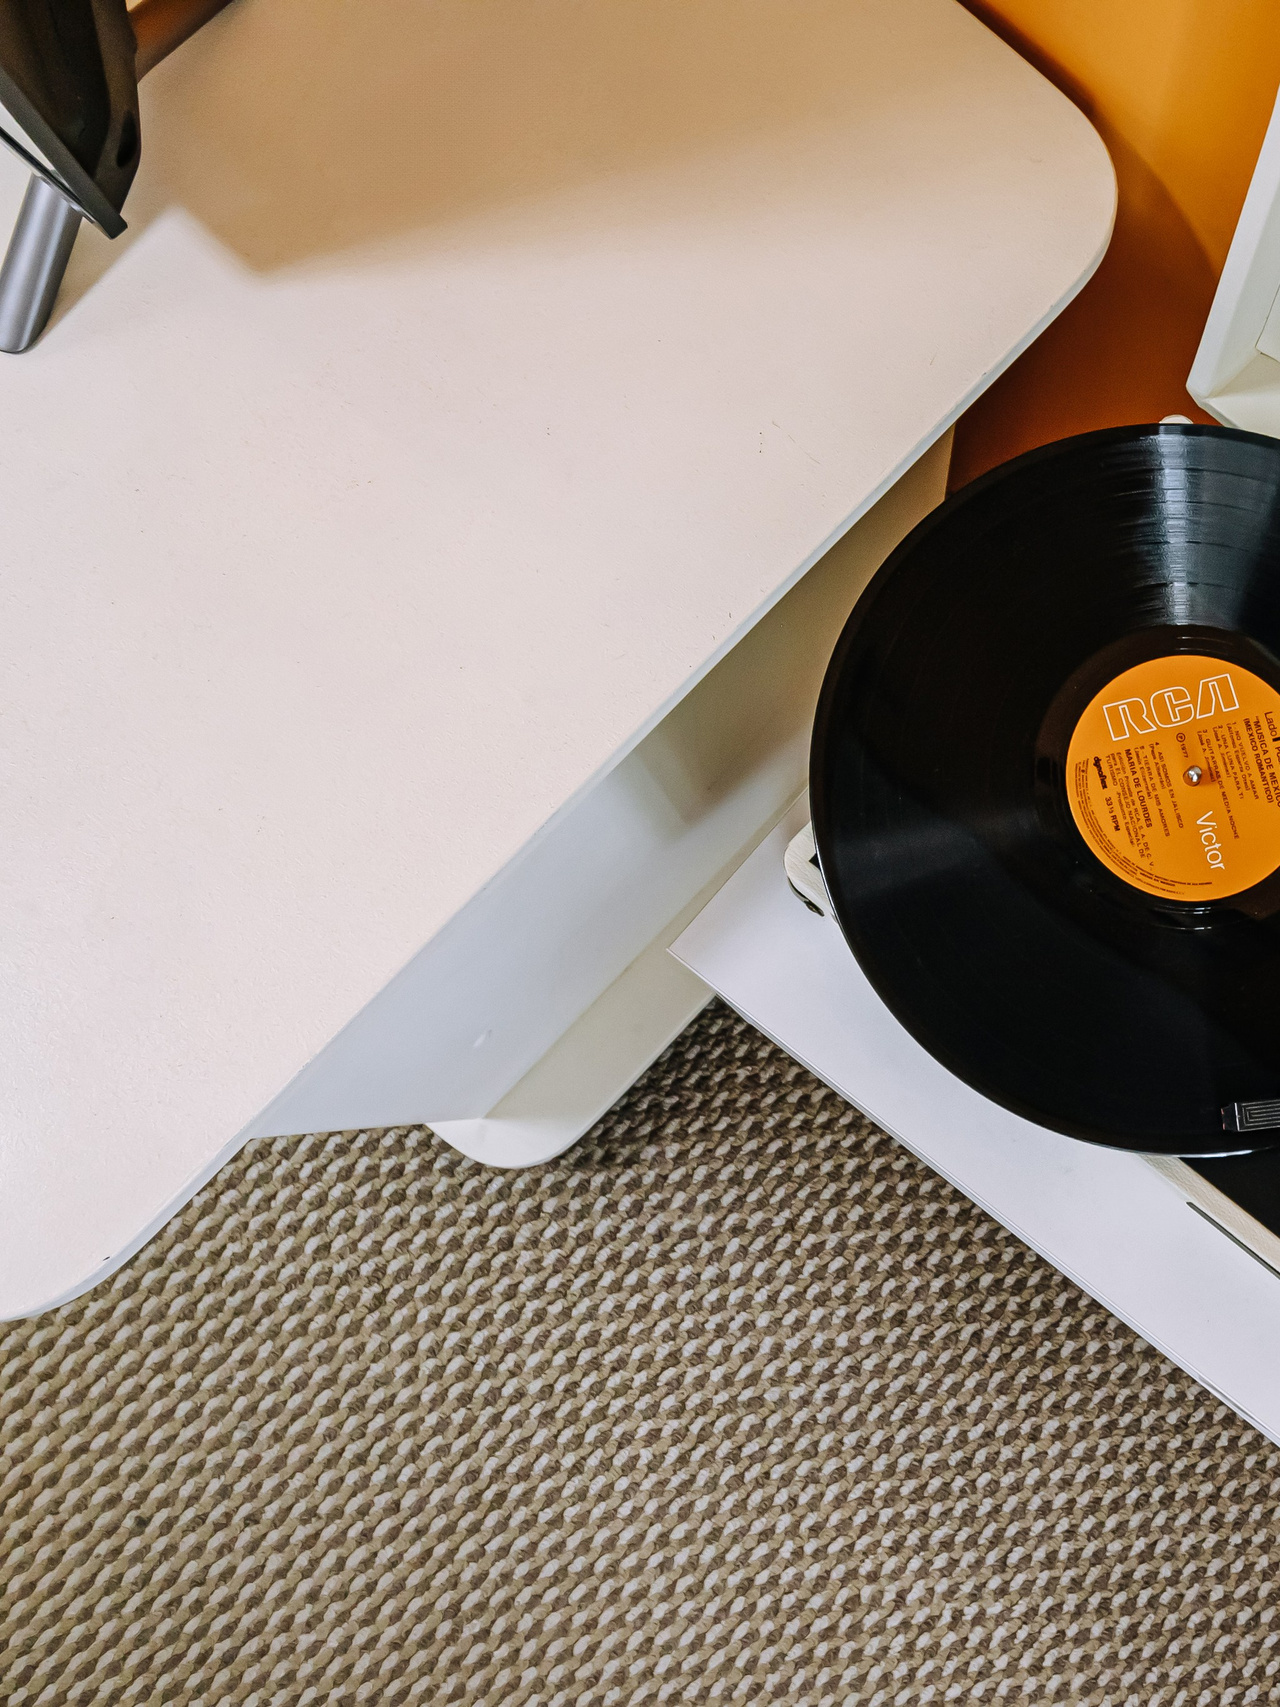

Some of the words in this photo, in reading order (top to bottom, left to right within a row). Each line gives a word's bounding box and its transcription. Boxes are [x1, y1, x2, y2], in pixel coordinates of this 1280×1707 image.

[1103, 673, 1239, 742] RCA
[1264, 711, 1278, 737] Lado
[1106, 755, 1118, 786] TURISMO
[1125, 749, 1137, 776] MARIA
[1137, 790, 1153, 828] LOURDES
[1206, 738, 1221, 780] GUITARRAS
[1222, 791, 1231, 814] MEDIA
[1229, 815, 1240, 839] NOCHE
[1221, 734, 1229, 749] UNA
[1226, 751, 1235, 770] LUNA
[1233, 772, 1241, 791] PARA
[1238, 742, 1251, 771] VUELVO
[1250, 780, 1259, 800] AMAR
[1243, 718, 1258, 752] (MEXICO
[1254, 753, 1274, 803] ROMANTICO)
[1264, 757, 1274, 770] DE
[1111, 815, 1121, 832] RPM
[1118, 778, 1131, 809] CONSEJO
[1129, 810, 1141, 847] NACIONAL
[1143, 755, 1154, 782] TIERRA
[1158, 808, 1170, 837] AMORES
[1161, 763, 1172, 788] SOMOS
[1172, 801, 1184, 829] JALISCO
[1197, 811, 1225, 869] Victor
